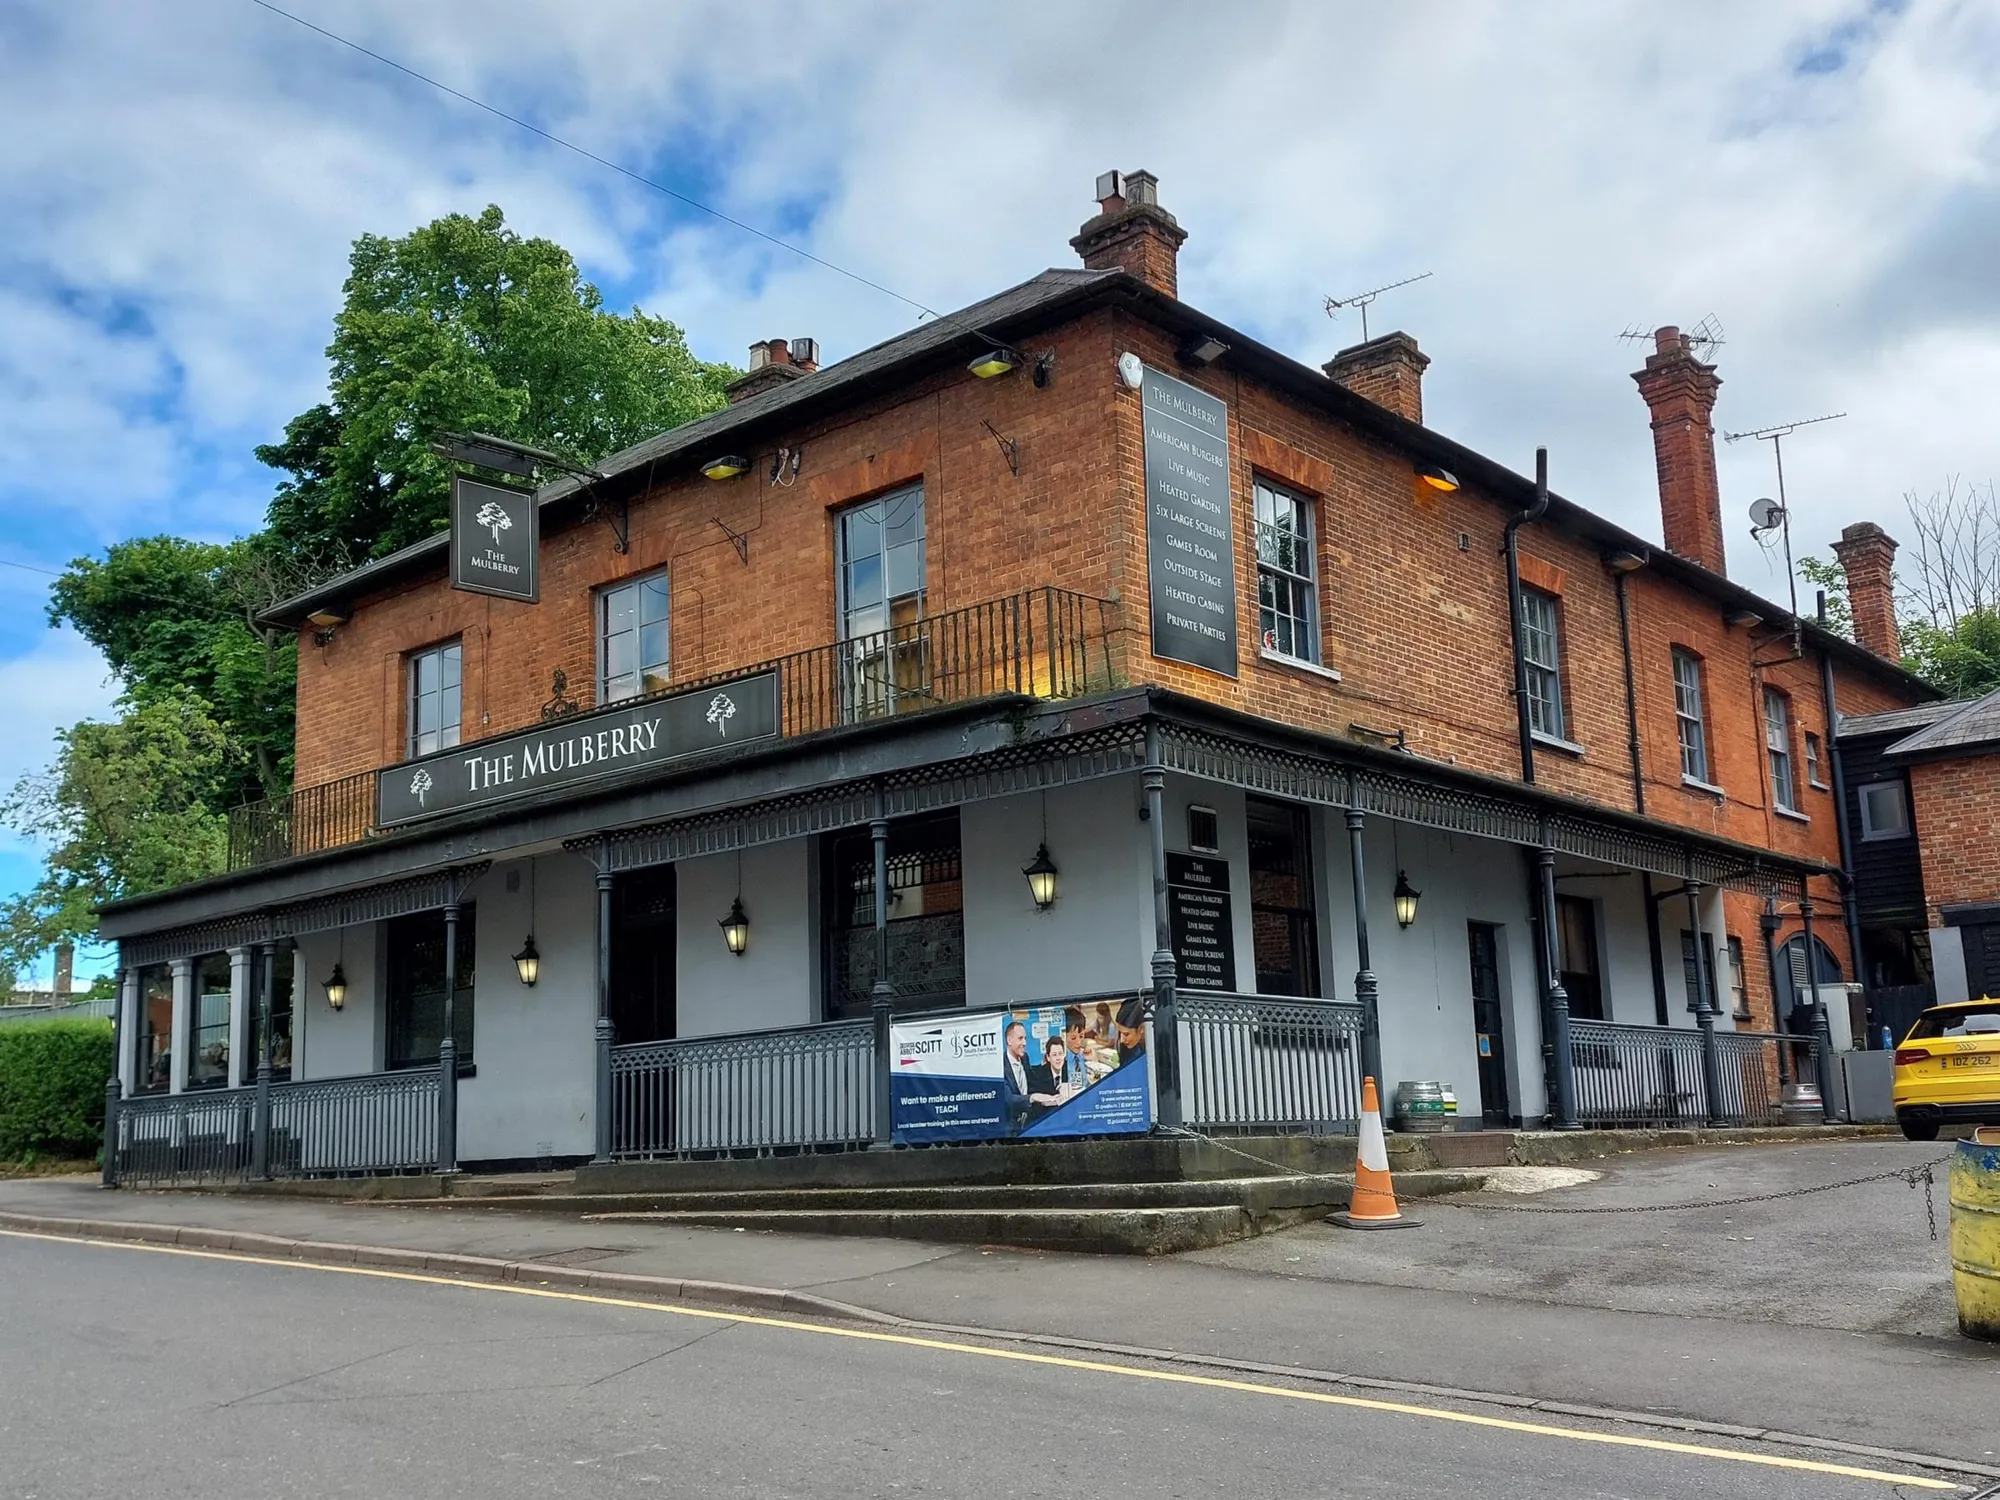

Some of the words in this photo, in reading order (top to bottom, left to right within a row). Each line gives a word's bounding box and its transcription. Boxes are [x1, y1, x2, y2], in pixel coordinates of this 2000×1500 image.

[1153, 386, 1171, 405] THE
[1173, 396, 1217, 426] MULBERRY
[1150, 426, 1190, 452] AMERICAN
[1191, 444, 1223, 467] BURGERS
[1168, 458, 1184, 475] LIVE
[1186, 466, 1210, 487] MUSIC
[1159, 480, 1189, 501] HEATED
[1190, 494, 1221, 514] GARDEN
[1156, 504, 1168, 518] SIX
[1170, 509, 1194, 528] LARGE
[1195, 519, 1227, 540] SCREENS
[485, 549, 506, 562] THE
[1166, 534, 1192, 553] GAMES
[1194, 544, 1218, 562] ROOM
[471, 556, 520, 575] MULBERRY
[1164, 558, 1198, 580] OUTSIDE
[1200, 570, 1222, 588] STAGE
[1165, 584, 1196, 605] HEATED
[1197, 596, 1225, 615] CABINS
[1166, 612, 1198, 632] PRIVATE
[1199, 622, 1226, 642] PARTIES
[464, 754, 514, 792] THE
[520, 718, 661, 780] MULBERRY
[915, 1039, 942, 1054] SCITT
[963, 1032, 996, 1048] SCITT
[1971, 1055, 1991, 1065] 262
[900, 1096, 919, 1106] Want
[920, 1095, 928, 1104] to
[928, 1094, 948, 1104] make
[956, 1090, 997, 1102] difference?
[935, 1104, 959, 1114] TEACH
